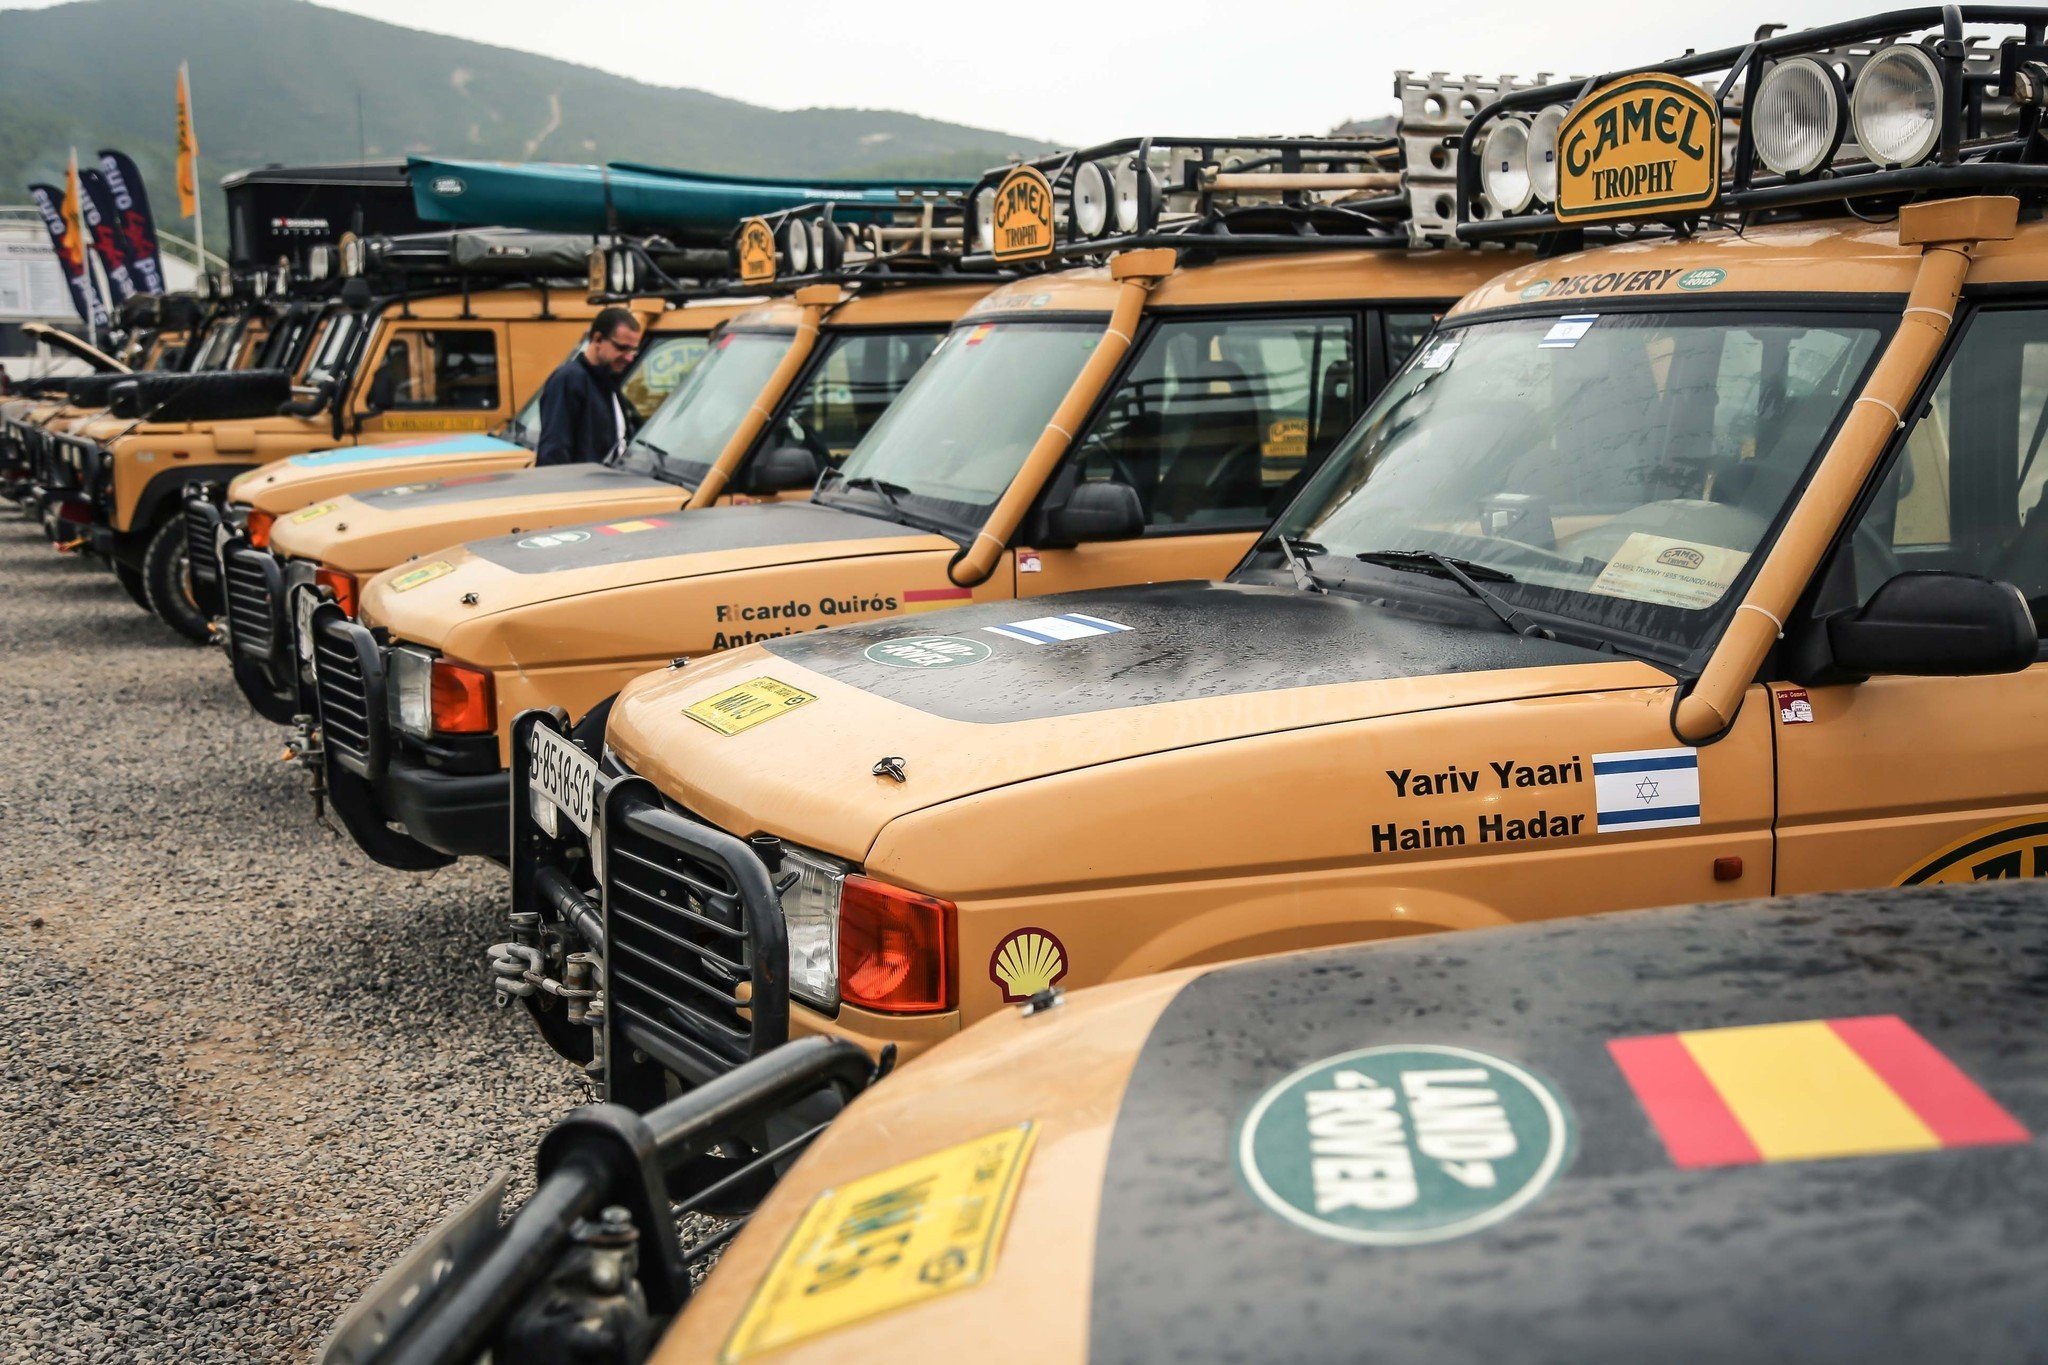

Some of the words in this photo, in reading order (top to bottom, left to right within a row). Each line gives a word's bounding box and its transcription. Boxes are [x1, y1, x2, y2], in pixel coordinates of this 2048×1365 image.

[1566, 96, 1705, 177] CAMEL
[1592, 160, 1677, 201] TROPHY
[996, 182, 1048, 228] CAMEL
[1006, 225, 1038, 248] TROPHY
[1546, 268, 1683, 297] DISCOVERY
[1683, 278, 1717, 286] ROVER
[1689, 270, 1717, 278] LAND
[1636, 566, 1662, 577] TROPHY
[1662, 550, 1699, 565] CAMEL
[716, 601, 812, 623] Ricardo
[819, 593, 898, 616] Quirós
[713, 627, 804, 650] Anto
[910, 638, 974, 655] LAND
[880, 645, 955, 667] ROVER
[530, 731, 590, 823] B-8518-SC
[1386, 766, 1480, 798] Yariv
[1489, 756, 1583, 789] Yaari
[1371, 820, 1466, 853] Haim
[1478, 811, 1585, 843] Hadar
[1401, 1069, 1517, 1160] LAND
[1305, 1088, 1420, 1215] ROVER
